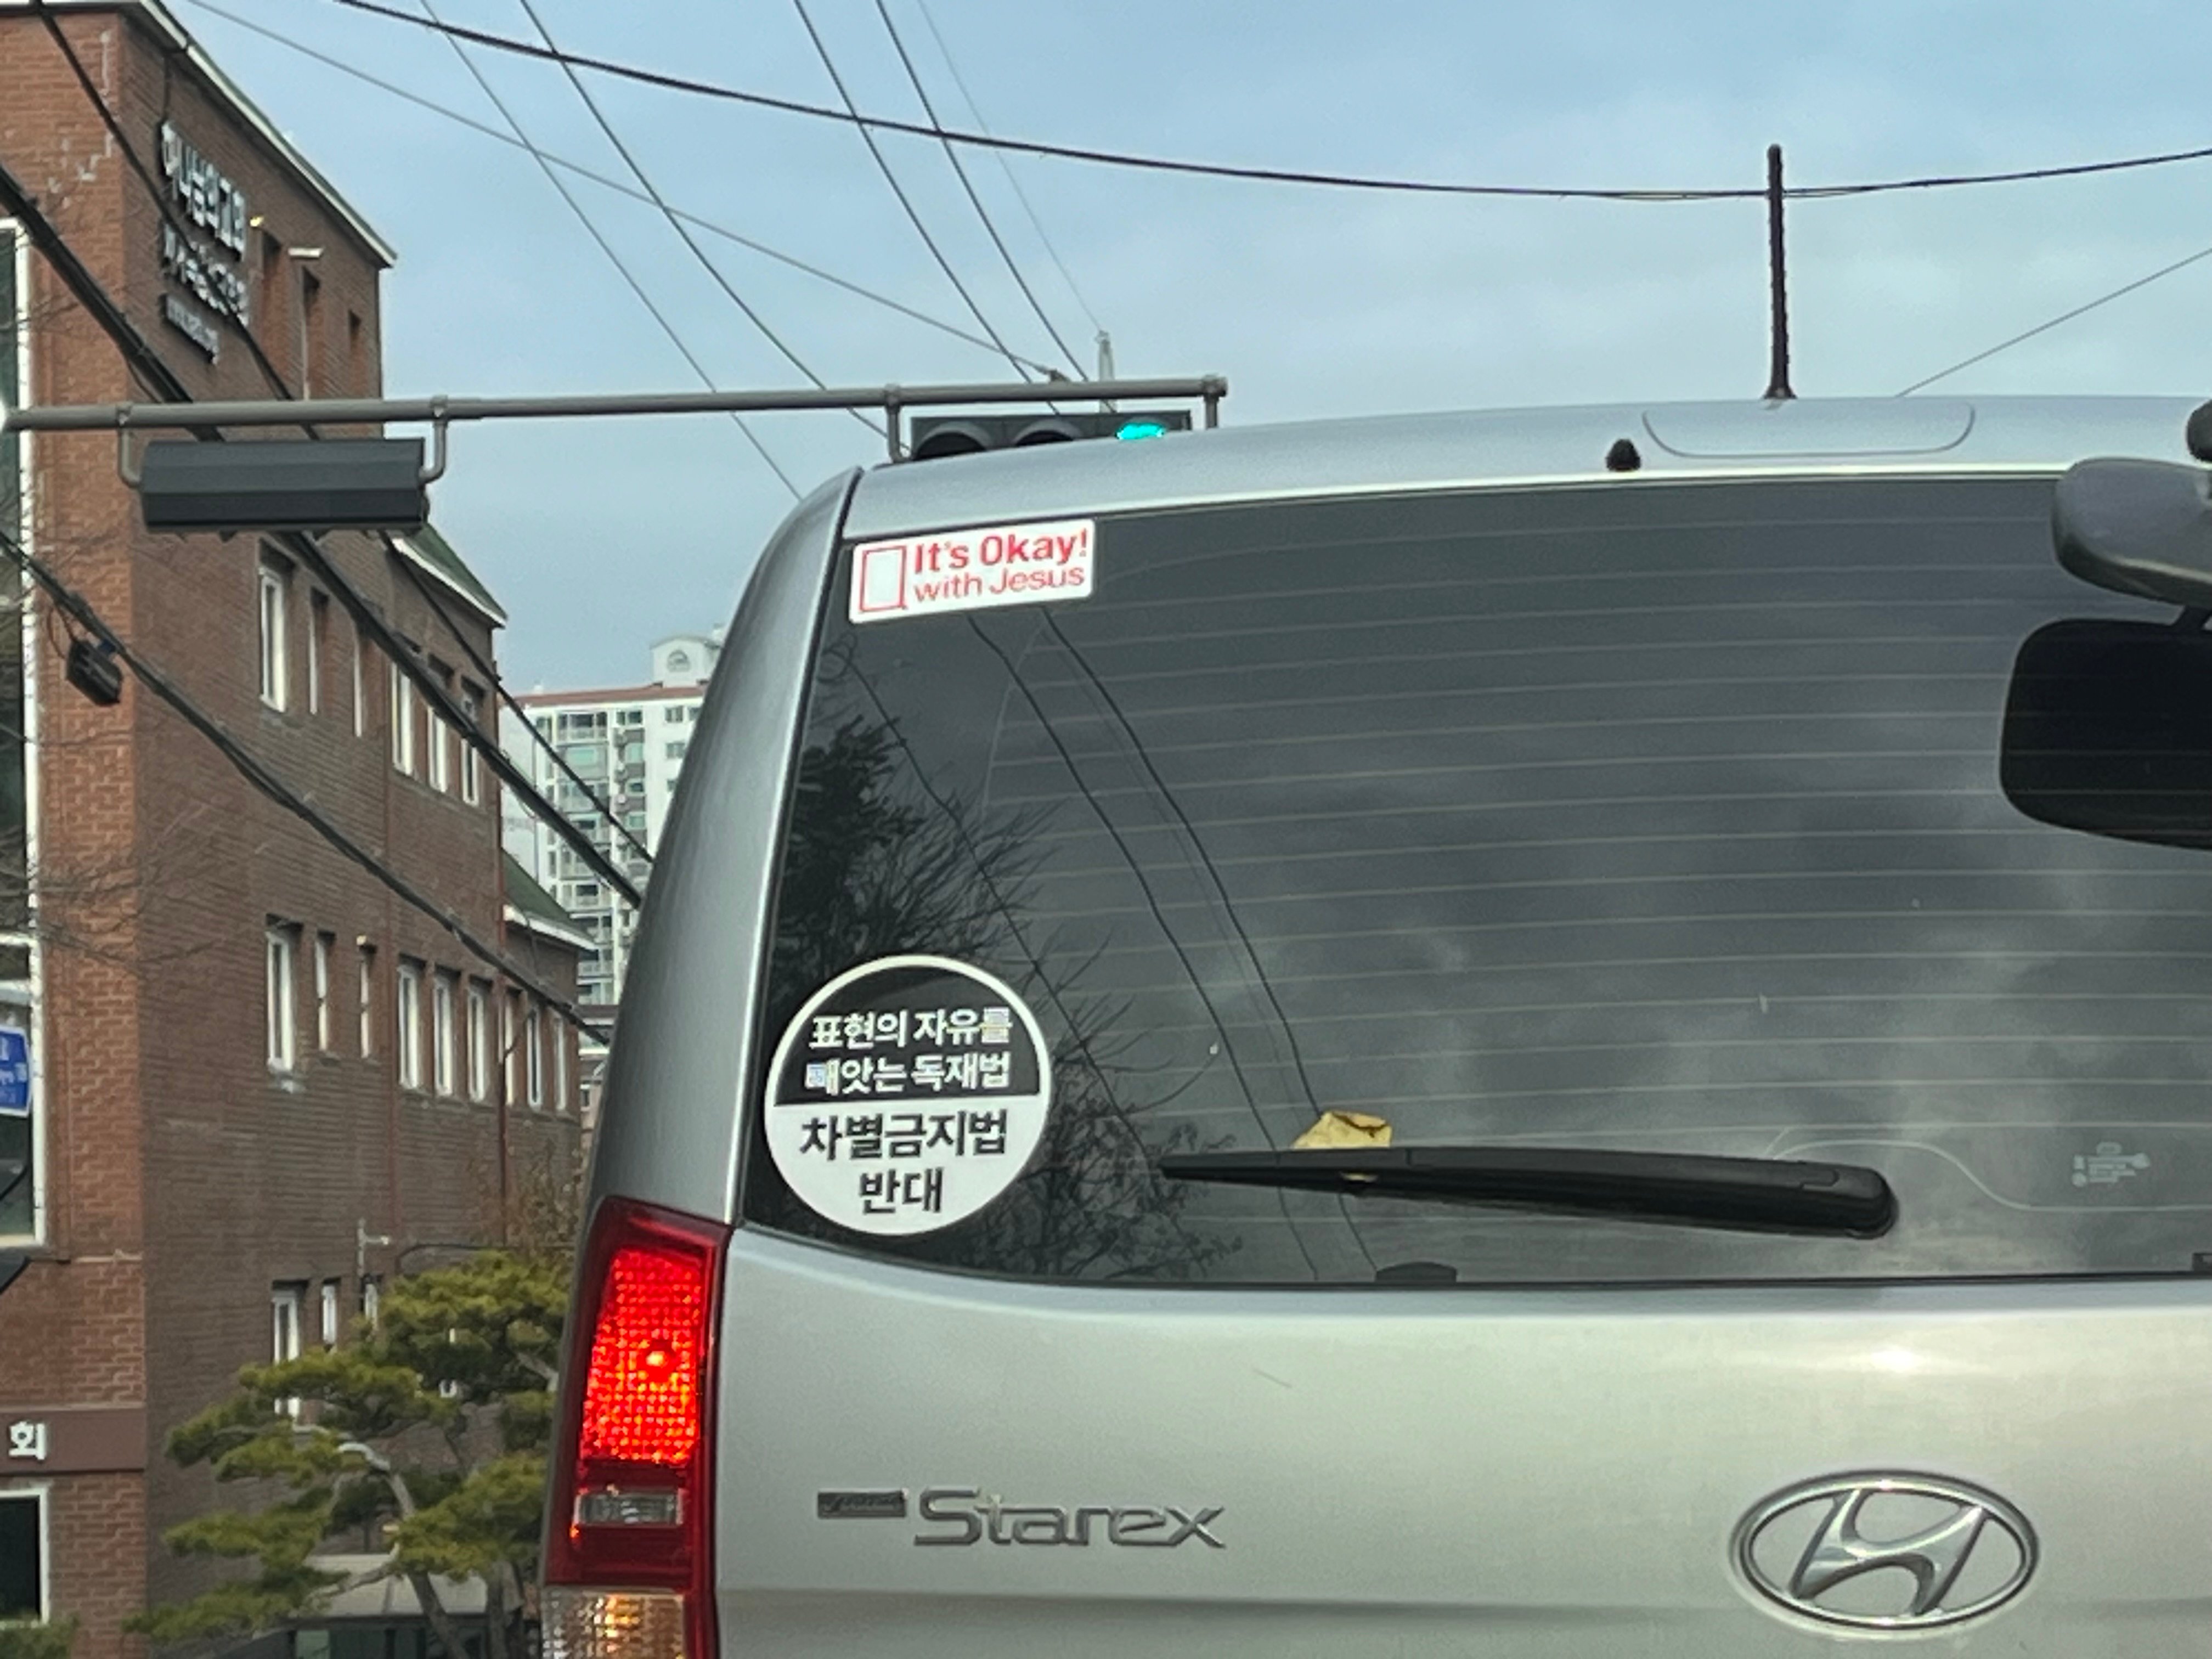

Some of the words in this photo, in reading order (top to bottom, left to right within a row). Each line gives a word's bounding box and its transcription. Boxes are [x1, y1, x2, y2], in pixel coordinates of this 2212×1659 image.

[913, 542, 969, 574] It's
[980, 528, 1088, 566] Okay!
[914, 572, 982, 602] with
[989, 566, 1085, 595] Jesus
[808, 1009, 907, 1049] 표현의
[913, 1006, 1013, 1046] 자유를
[804, 1057, 907, 1096] 빼앗는
[911, 1051, 1011, 1092] 독재법
[799, 1108, 1007, 1161] 차별금지법
[859, 1166, 944, 1215] 반대
[8, 1421, 46, 1460] 회
[914, 1487, 1226, 1548] Starex
